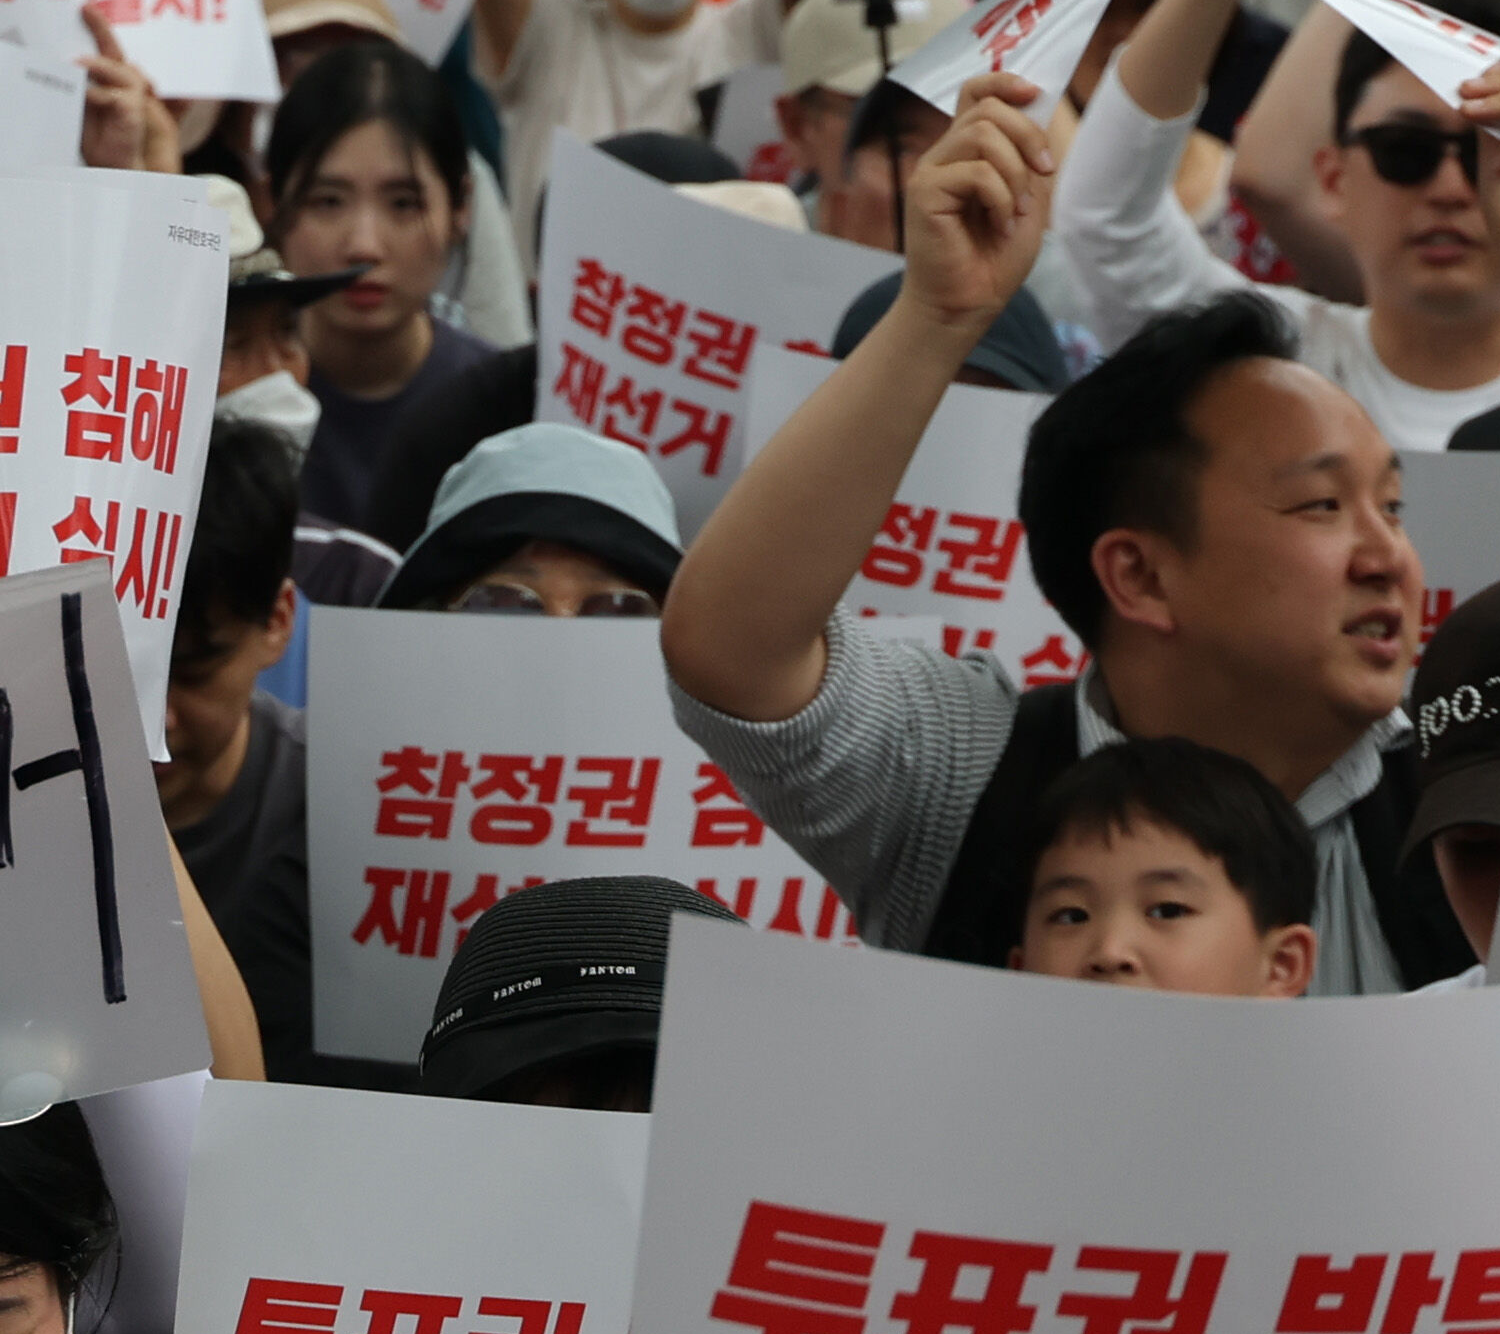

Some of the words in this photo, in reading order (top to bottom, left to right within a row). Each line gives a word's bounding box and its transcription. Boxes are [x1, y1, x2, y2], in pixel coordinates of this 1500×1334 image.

[168, 225, 220, 251] 자유대한호국단
[565, 260, 756, 393] 참정권
[62, 349, 187, 473] 침해
[555, 339, 740, 476] 재선거
[376, 747, 661, 847] 참정권
